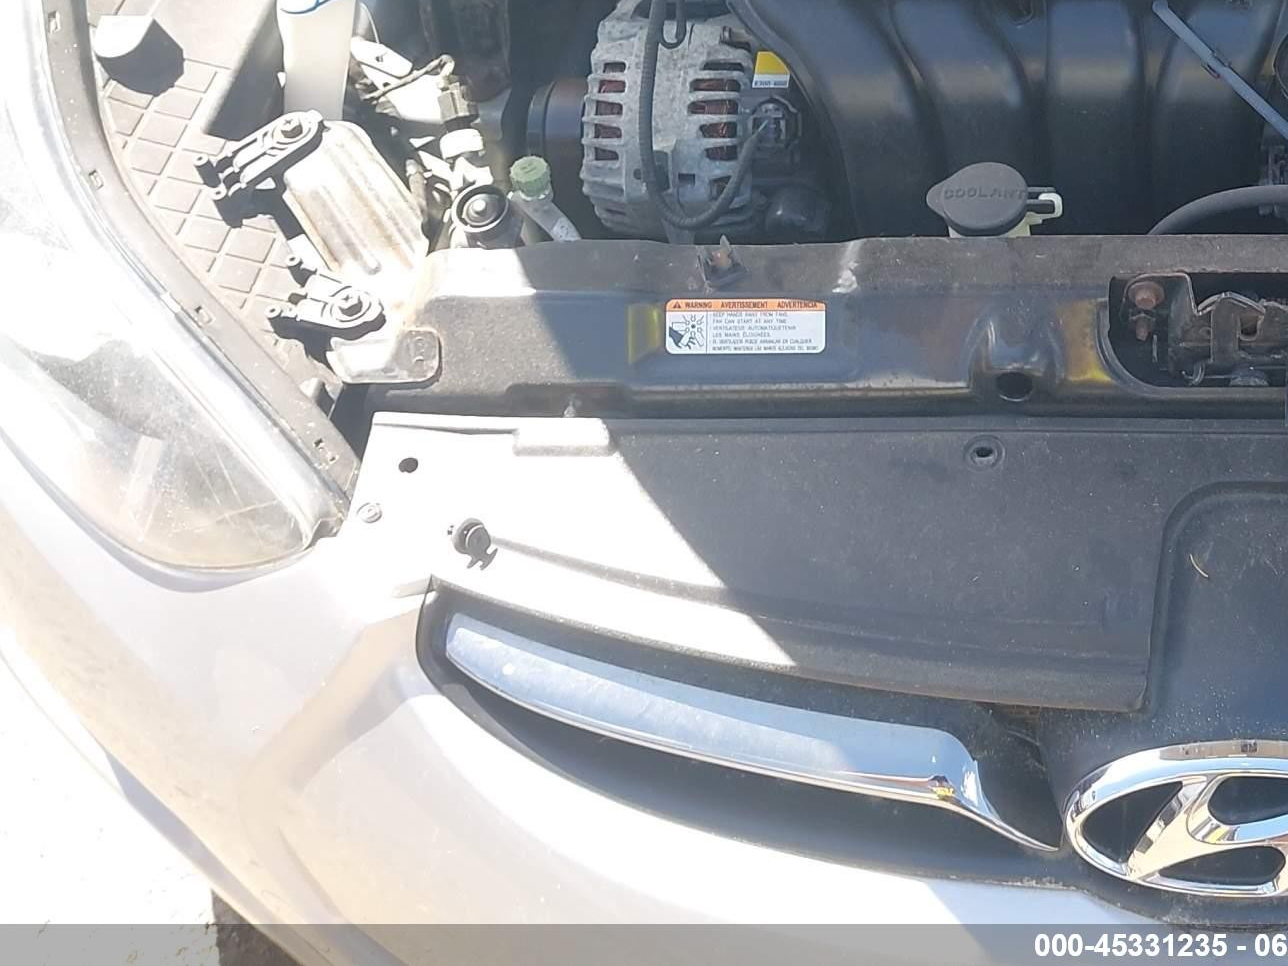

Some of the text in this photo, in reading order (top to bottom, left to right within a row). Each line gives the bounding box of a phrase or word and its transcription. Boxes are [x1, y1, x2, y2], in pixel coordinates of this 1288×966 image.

[944, 187, 1026, 201] COOLANT
[720, 301, 768, 309] AVERTISSEMENT
[777, 301, 818, 309] ADVERTENCIA
